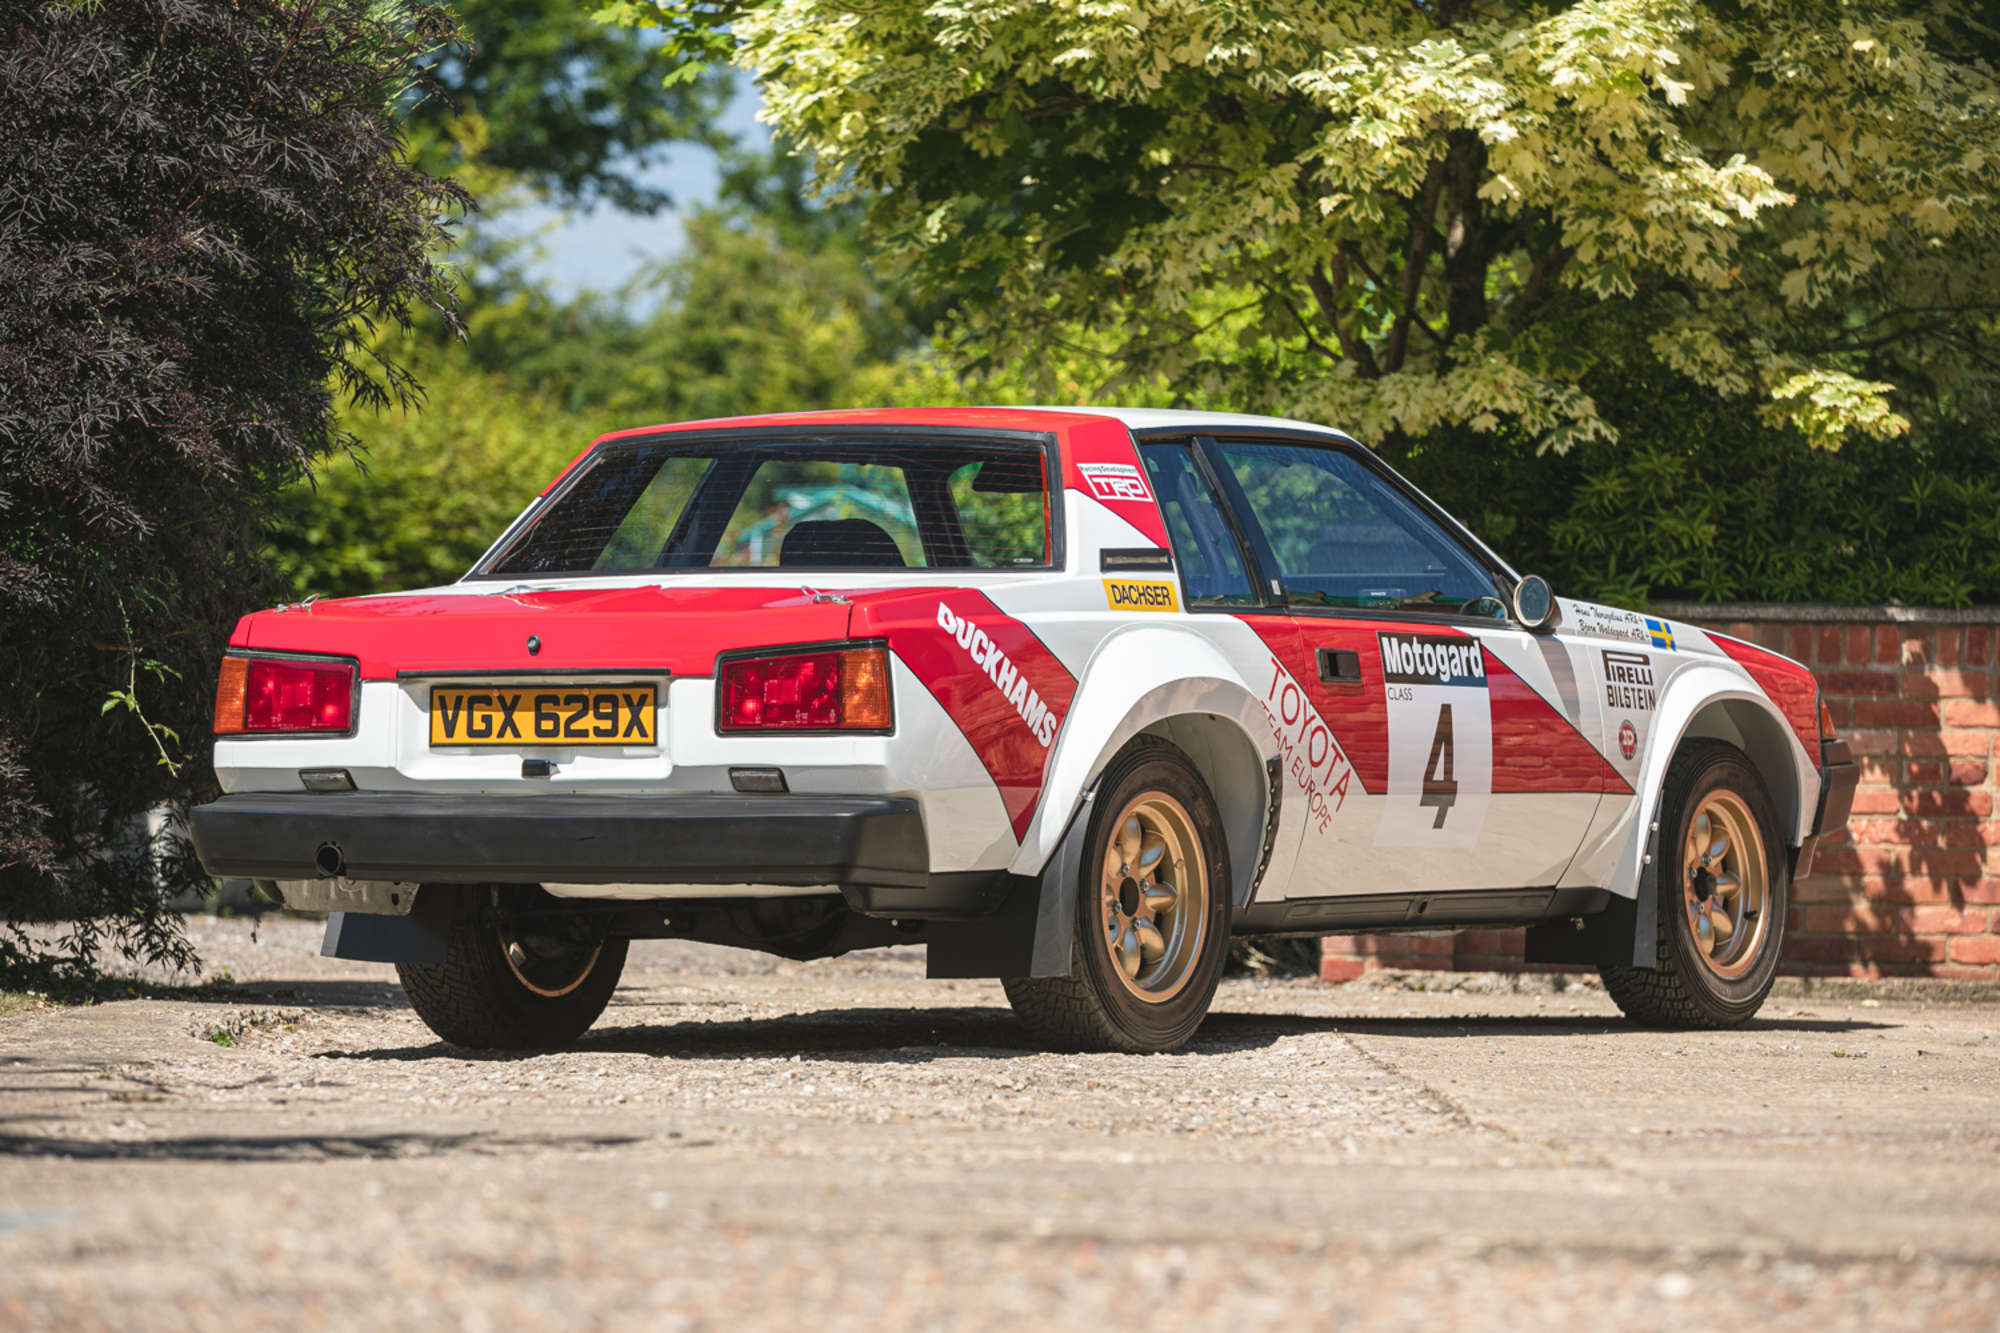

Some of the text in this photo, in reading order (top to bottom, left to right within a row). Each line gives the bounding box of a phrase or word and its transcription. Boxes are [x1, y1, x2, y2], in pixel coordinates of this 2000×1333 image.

[1110, 584, 1172, 606] DACHSER
[937, 601, 1057, 748] DUCKHAMS
[1381, 636, 1485, 682] Motogard
[1601, 650, 1654, 686] PIRELLI
[437, 694, 649, 739] VGX 629X
[1387, 687, 1413, 701] CLASS
[1606, 685, 1656, 711] BILSTEIN
[1268, 657, 1351, 814] TOYOTA
[1260, 700, 1333, 835] TEAM EUROPE
[1419, 703, 1458, 829] 4
